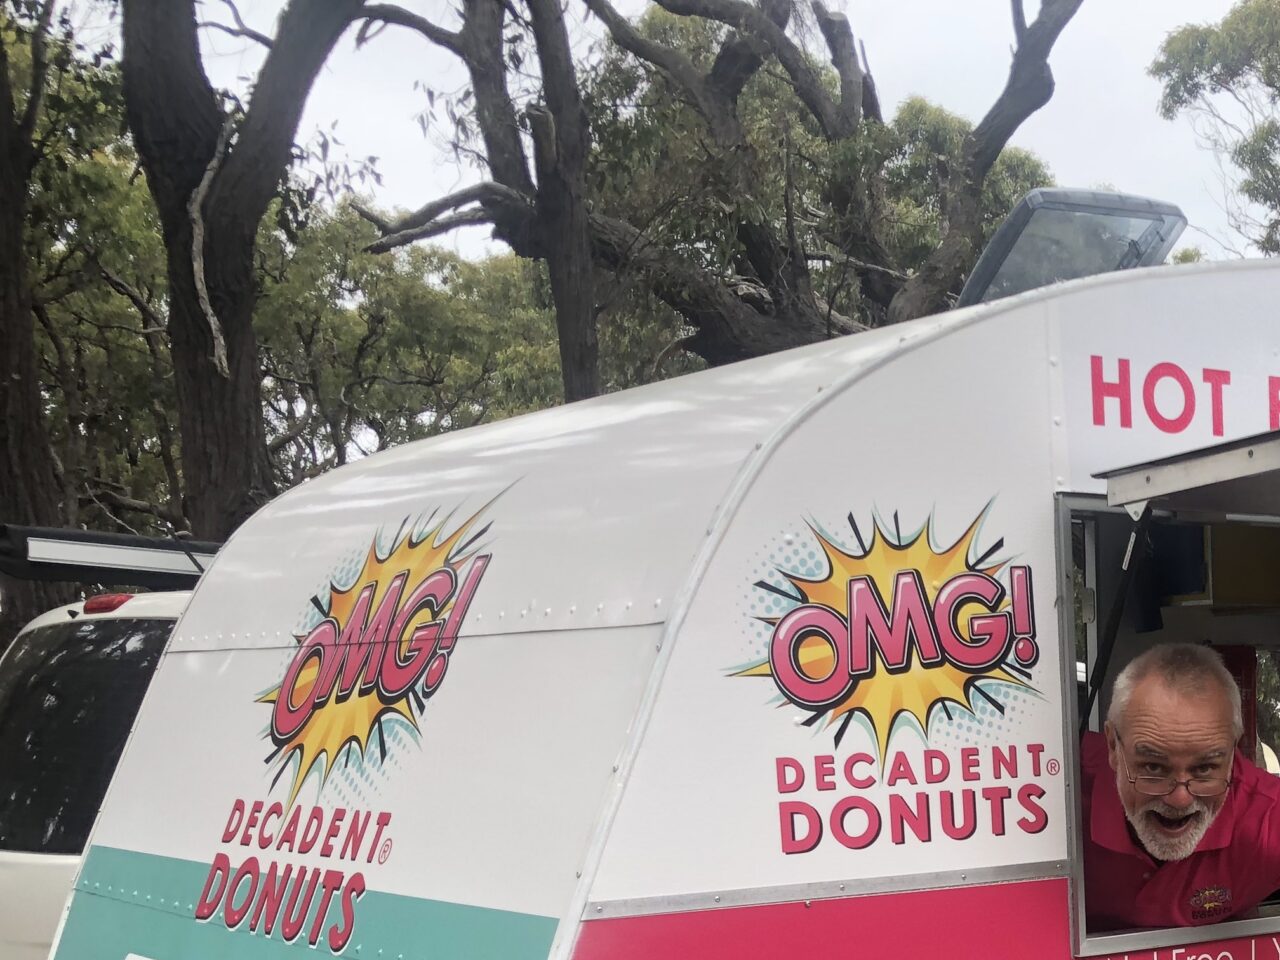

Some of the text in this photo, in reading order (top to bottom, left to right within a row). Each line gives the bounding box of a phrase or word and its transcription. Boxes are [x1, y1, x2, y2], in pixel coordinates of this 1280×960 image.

[1090, 355, 1231, 437] HOT
[271, 552, 493, 748] OMG!
[768, 564, 1039, 712] OMG!
[778, 782, 1049, 855] DONUTS
[195, 852, 366, 956] DONUTS
